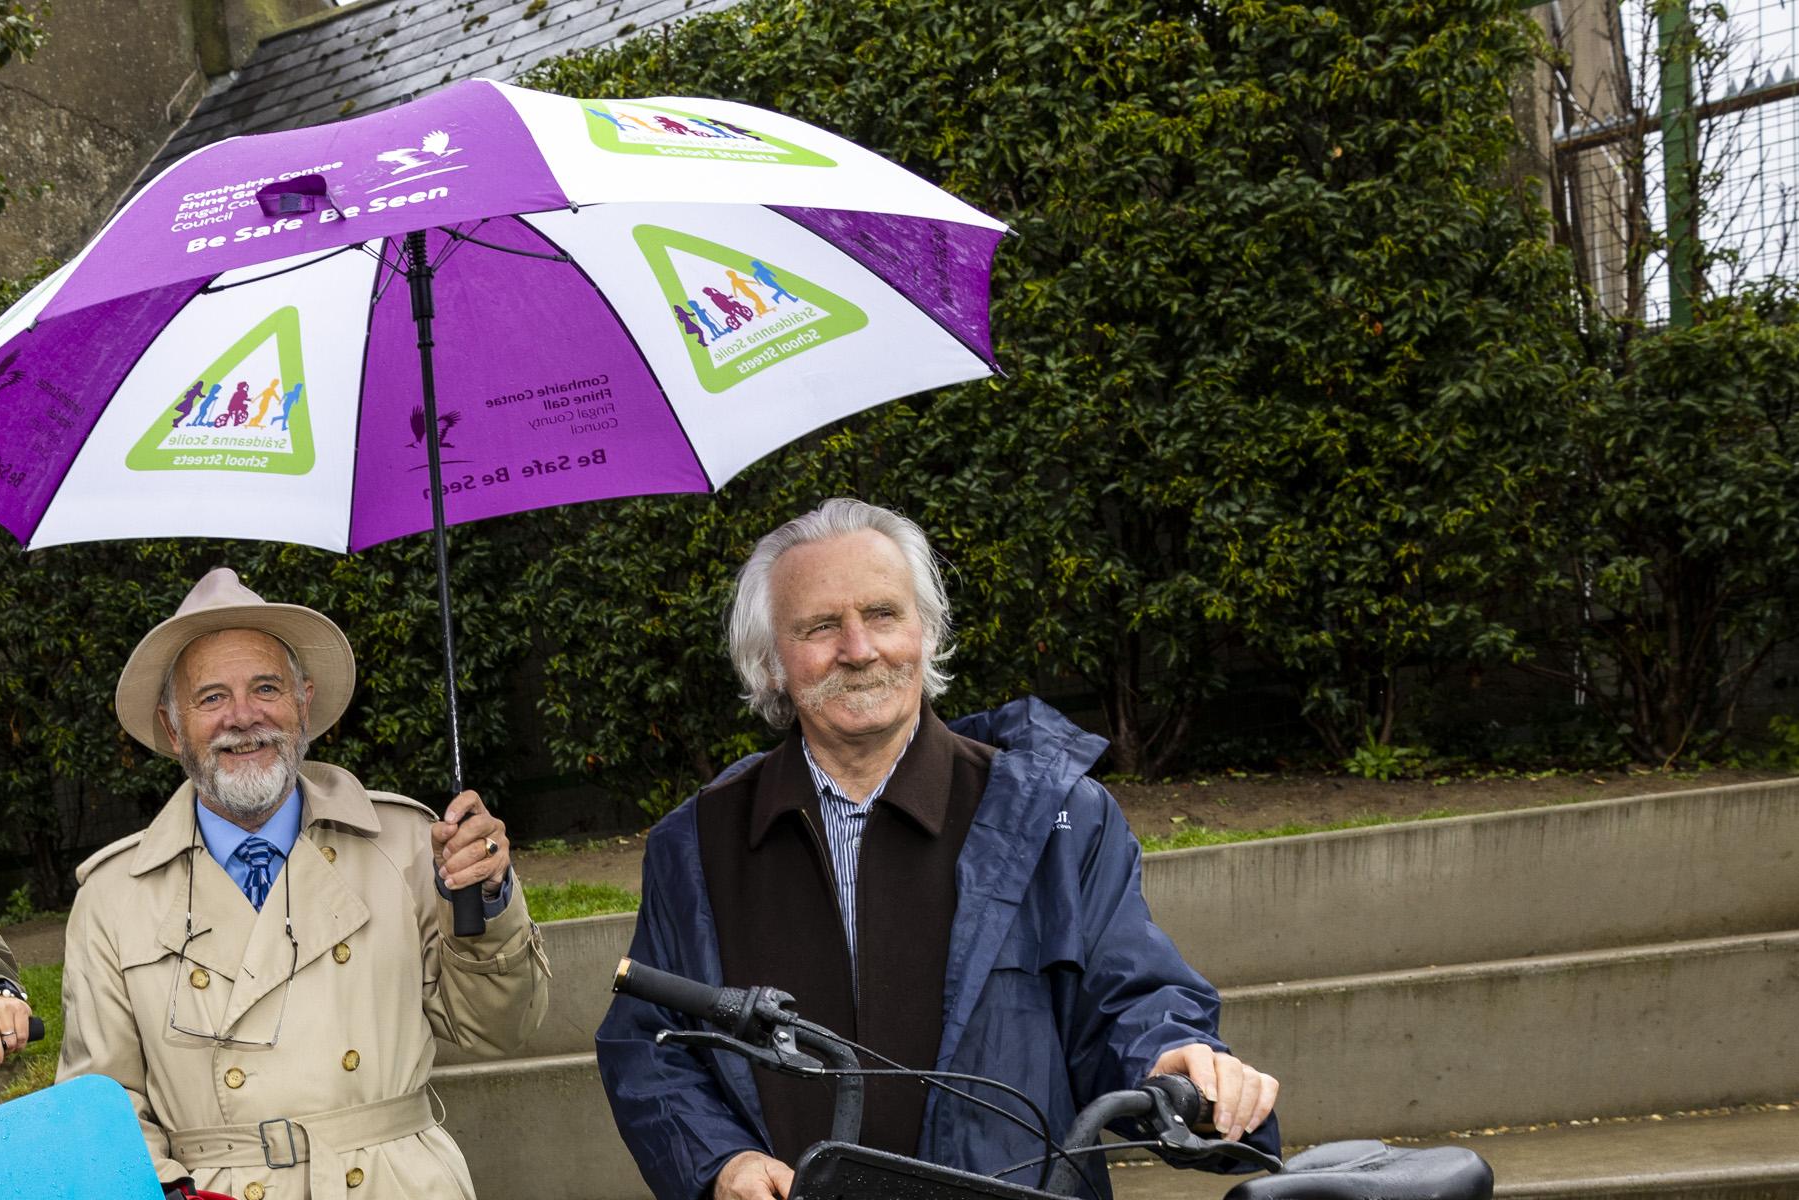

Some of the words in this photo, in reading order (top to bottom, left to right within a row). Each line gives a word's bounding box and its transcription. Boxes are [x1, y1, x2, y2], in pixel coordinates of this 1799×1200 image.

[183, 178, 275, 202] Comhairle
[279, 161, 343, 182] Contae
[175, 204, 224, 222] Fingal
[228, 199, 259, 210] Cou
[178, 196, 229, 212] Fhine
[171, 211, 233, 232] Council
[186, 235, 227, 253] Be
[233, 218, 304, 242] Safe
[319, 206, 361, 224] Be
[368, 186, 448, 212] Seen
